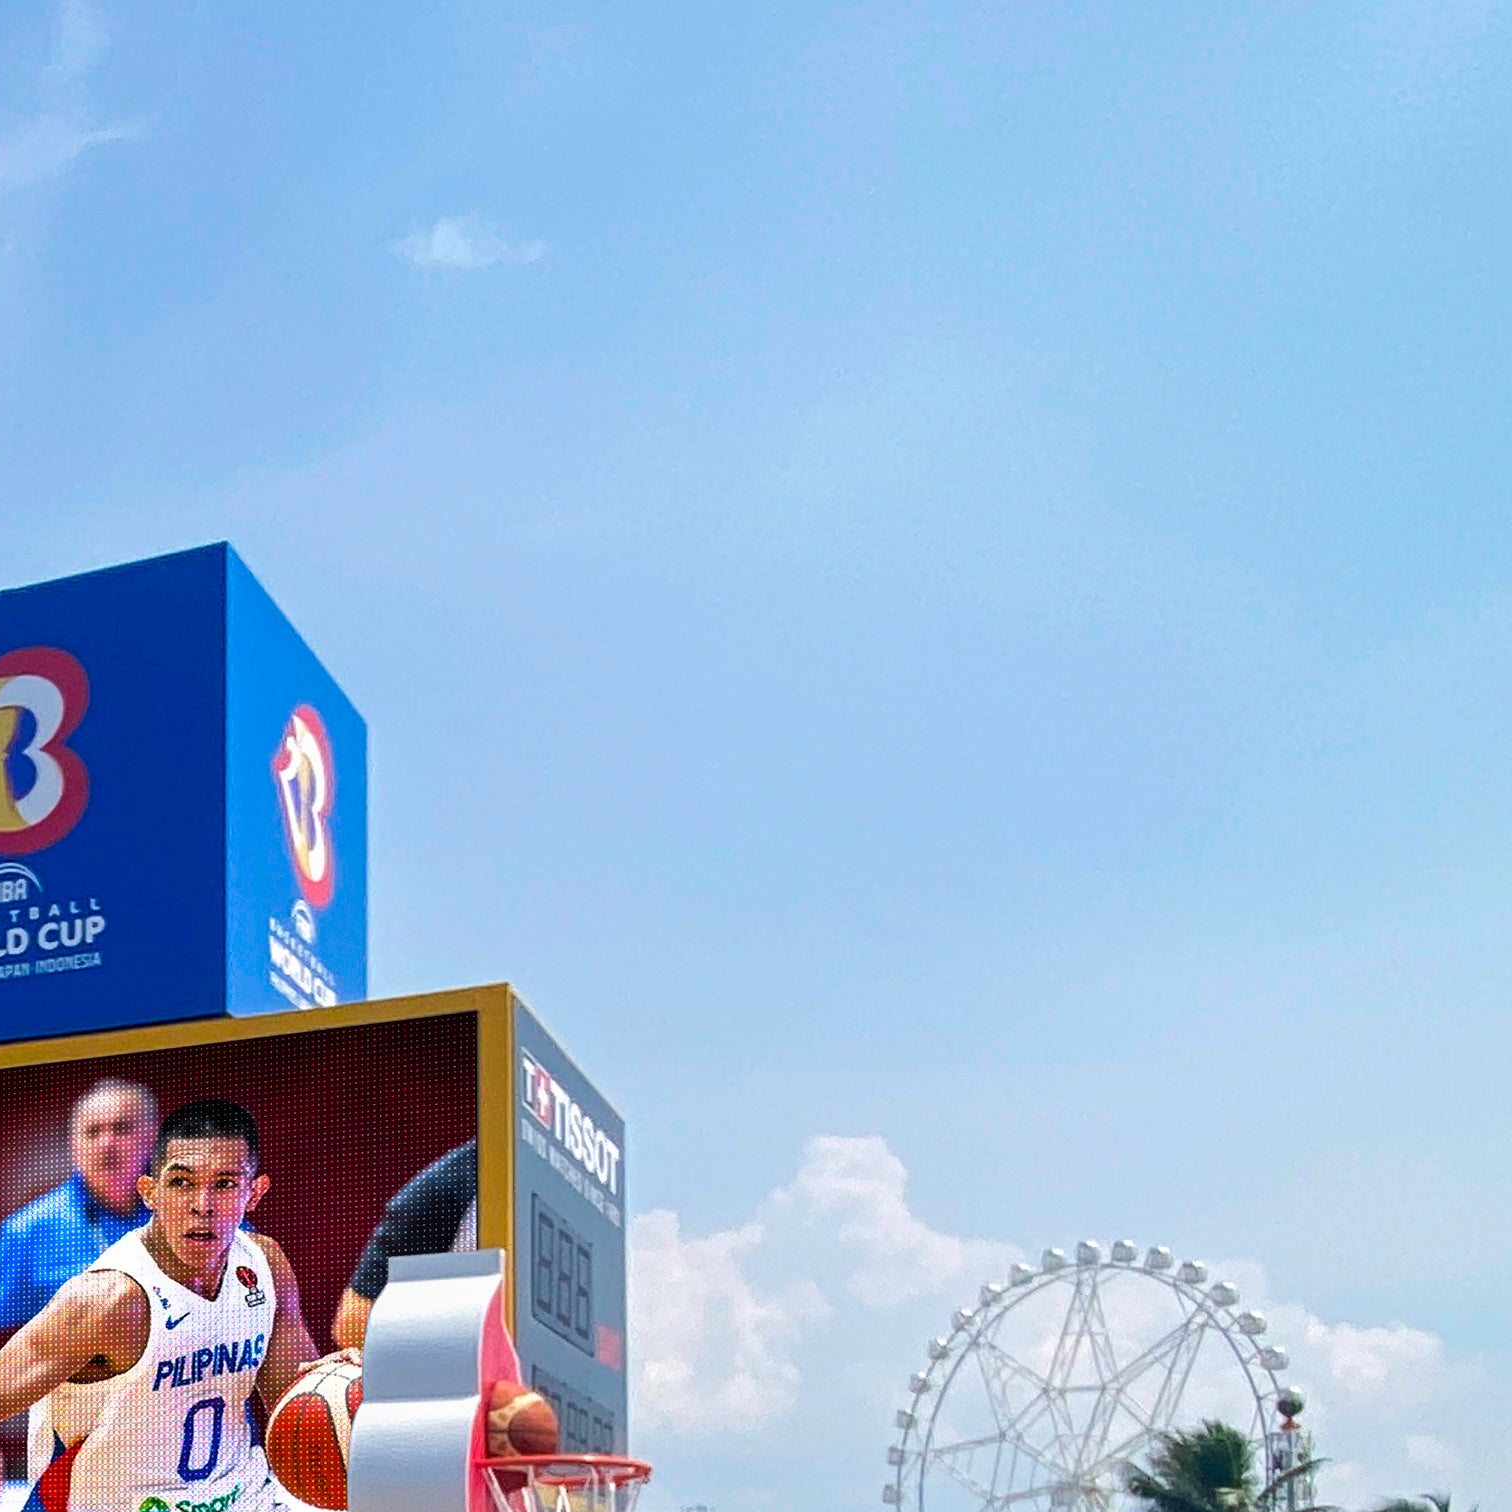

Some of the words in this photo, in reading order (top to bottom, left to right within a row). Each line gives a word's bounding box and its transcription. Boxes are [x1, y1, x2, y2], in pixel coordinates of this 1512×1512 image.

[38, 915, 106, 950] CUP
[550, 1077, 620, 1195] TISSOT
[177, 1396, 226, 1482] 0
